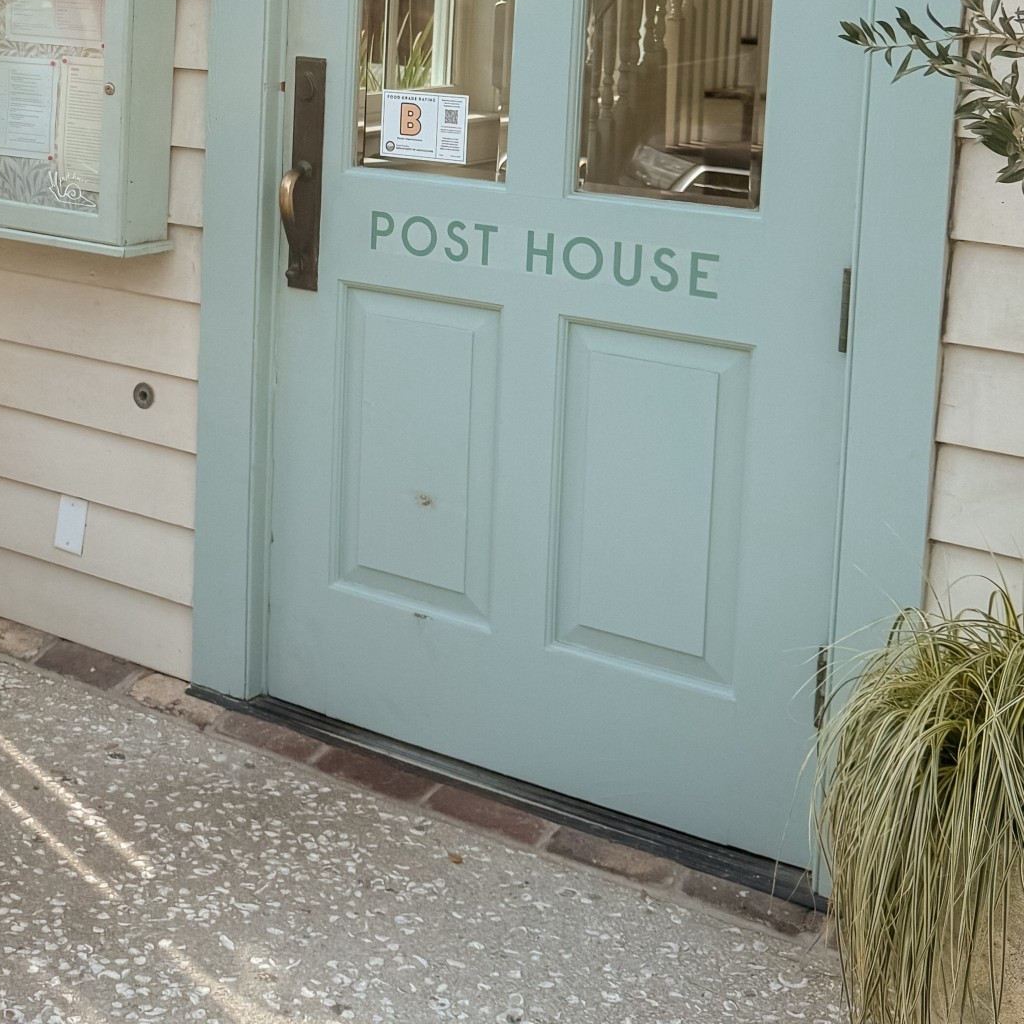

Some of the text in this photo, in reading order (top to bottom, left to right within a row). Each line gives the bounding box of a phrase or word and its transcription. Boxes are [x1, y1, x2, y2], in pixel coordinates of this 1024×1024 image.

[399, 102, 422, 136] B
[370, 210, 720, 300] POST HOUSE
